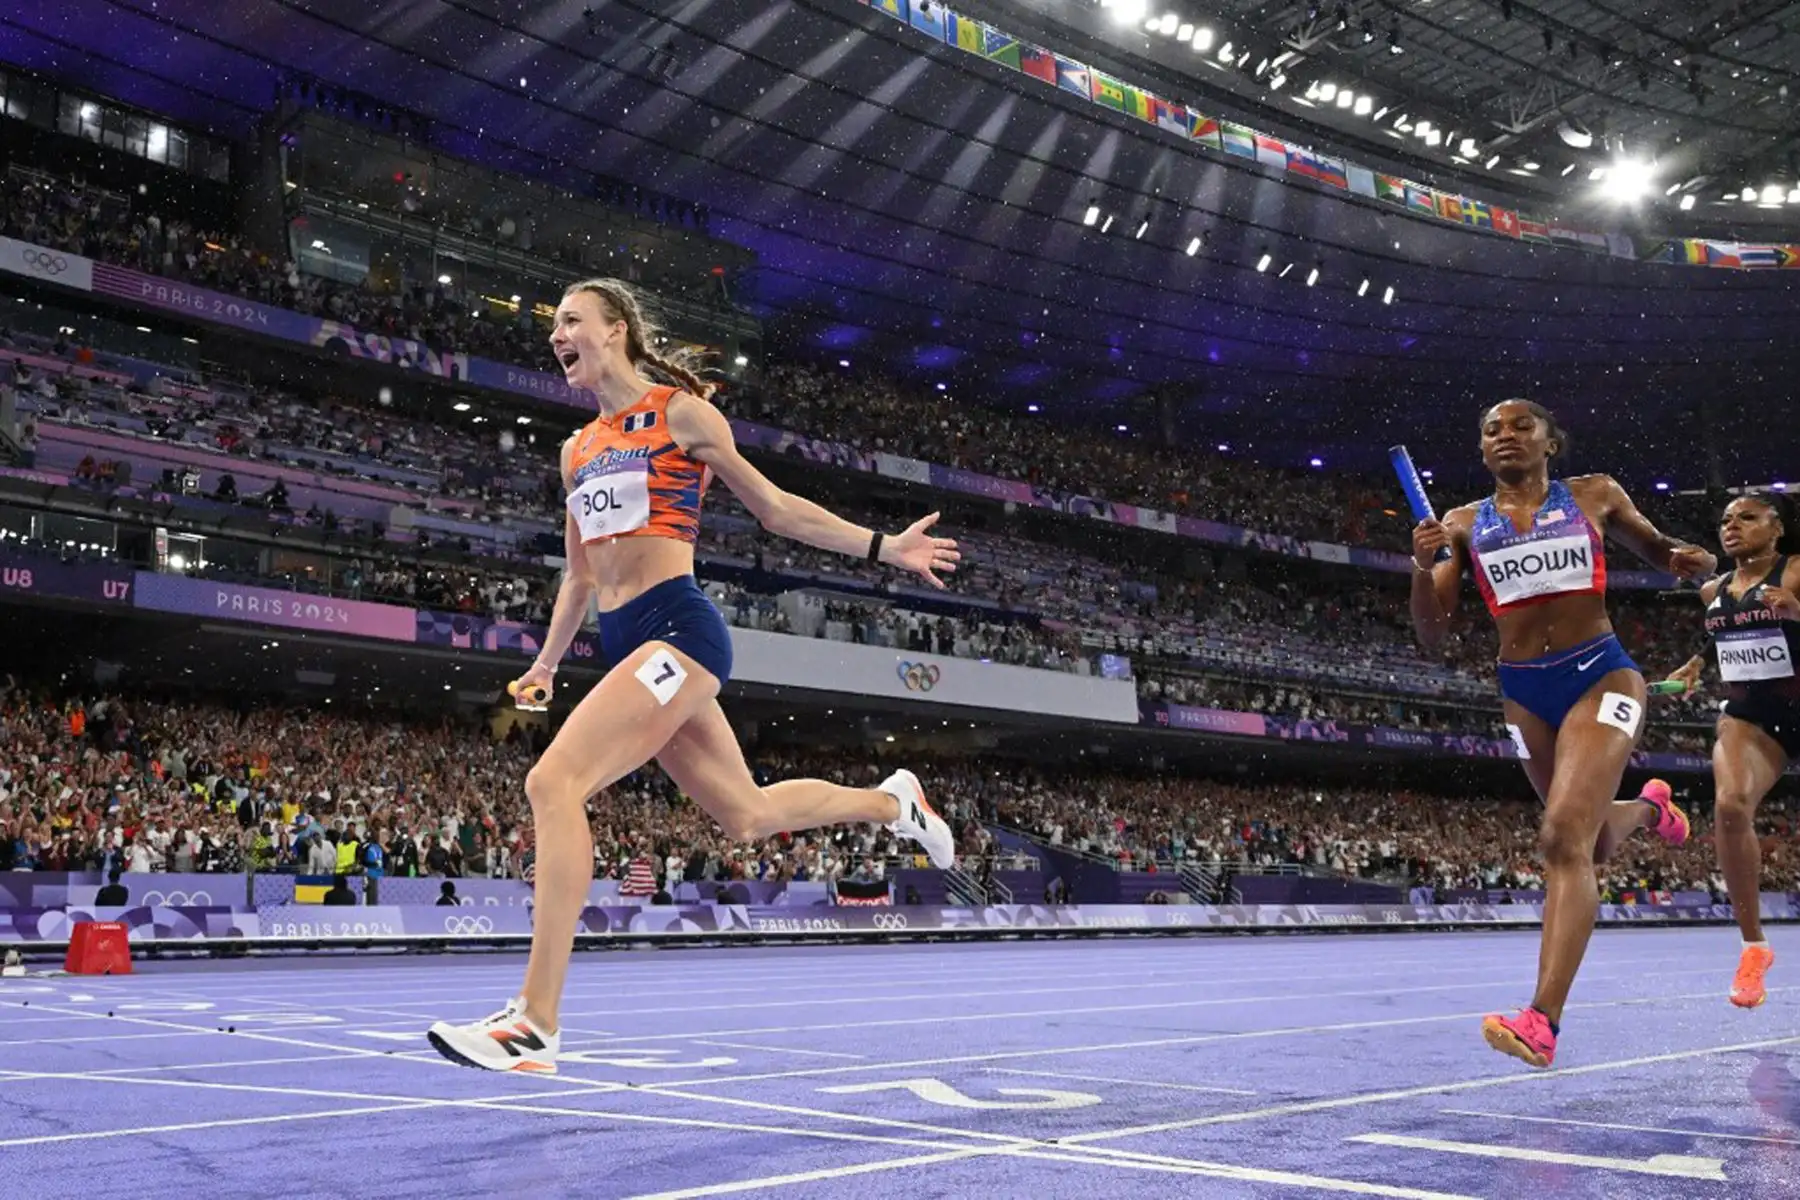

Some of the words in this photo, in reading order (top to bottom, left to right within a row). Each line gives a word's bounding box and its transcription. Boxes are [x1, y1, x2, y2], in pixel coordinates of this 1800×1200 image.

[142, 281, 205, 311] PARIS
[213, 299, 269, 325] 2024
[507, 371, 555, 394] PARIS
[582, 487, 622, 517] BOL
[1488, 546, 1589, 584] BROWN
[3, 567, 33, 588] U8
[103, 580, 130, 600] U7
[216, 589, 283, 616] PARIS
[291, 601, 349, 624] 2024
[573, 642, 595, 658] U6
[1720, 645, 1786, 666] ANNING
[653, 661, 677, 686] 7
[1612, 701, 1633, 724] 5
[272, 922, 333, 938] PARIS
[341, 922, 394, 938] 2024
[760, 918, 800, 932] PARIS
[803, 918, 840, 932] 2024
[813, 1077, 1104, 1110] 2
